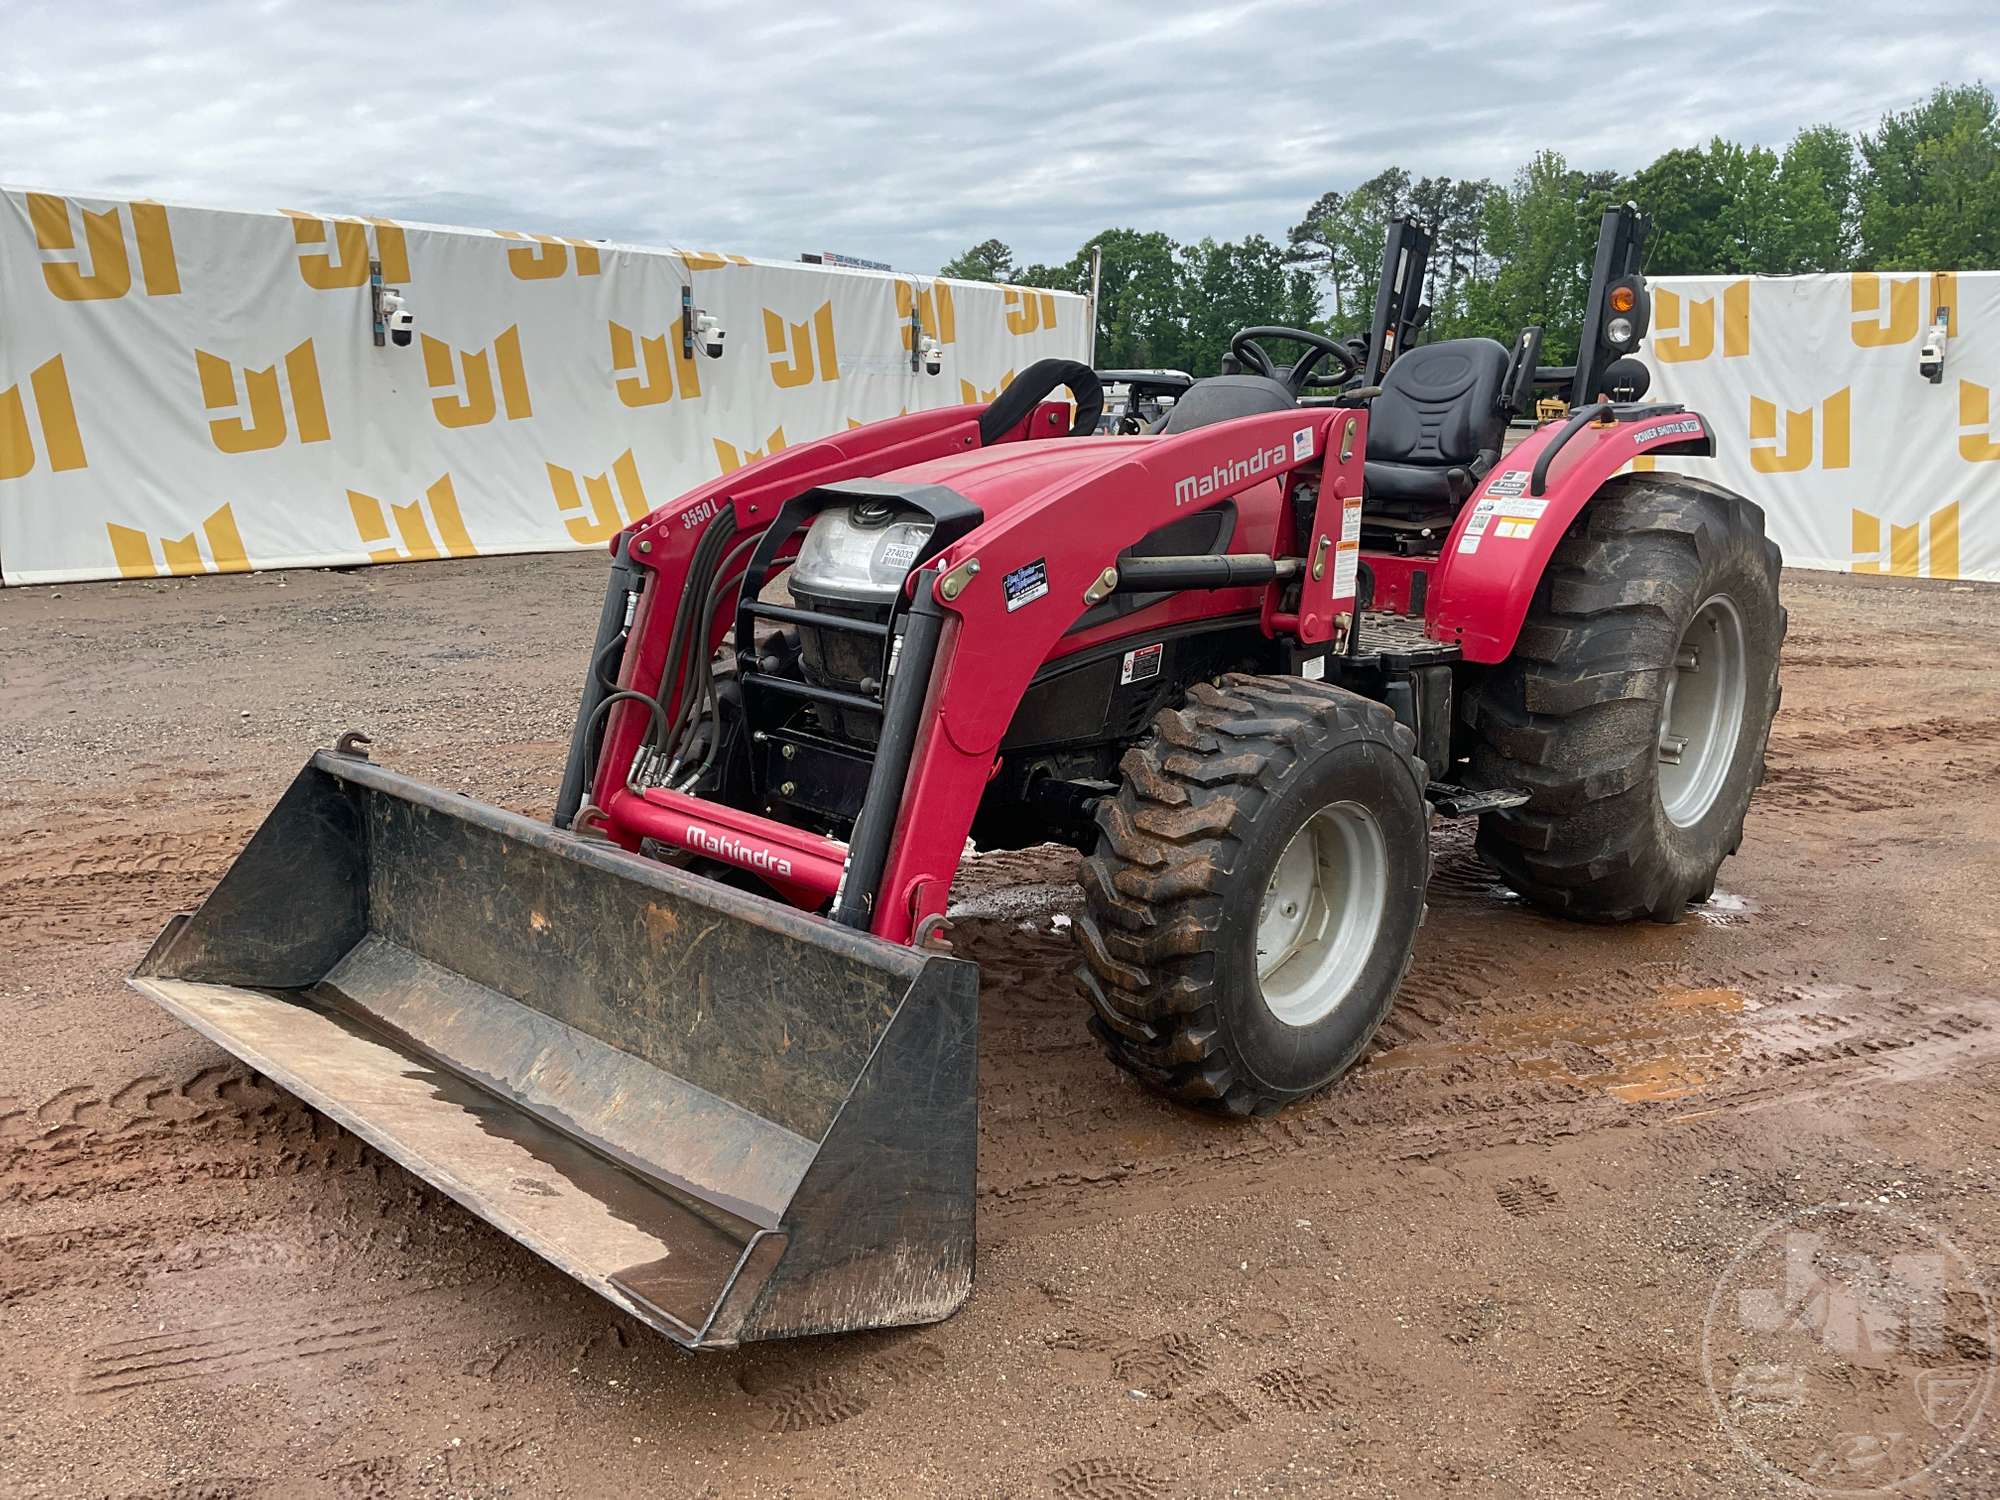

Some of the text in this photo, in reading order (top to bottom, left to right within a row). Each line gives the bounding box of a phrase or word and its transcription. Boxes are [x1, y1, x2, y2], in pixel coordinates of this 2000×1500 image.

[1633, 428, 1658, 444] POWER
[1657, 423, 1682, 436] SHUTTLE
[1175, 444, 1286, 506] Mahindra
[681, 497, 719, 529] 3550 L
[885, 548, 914, 560] 274033
[687, 825, 792, 876] Mahindra
